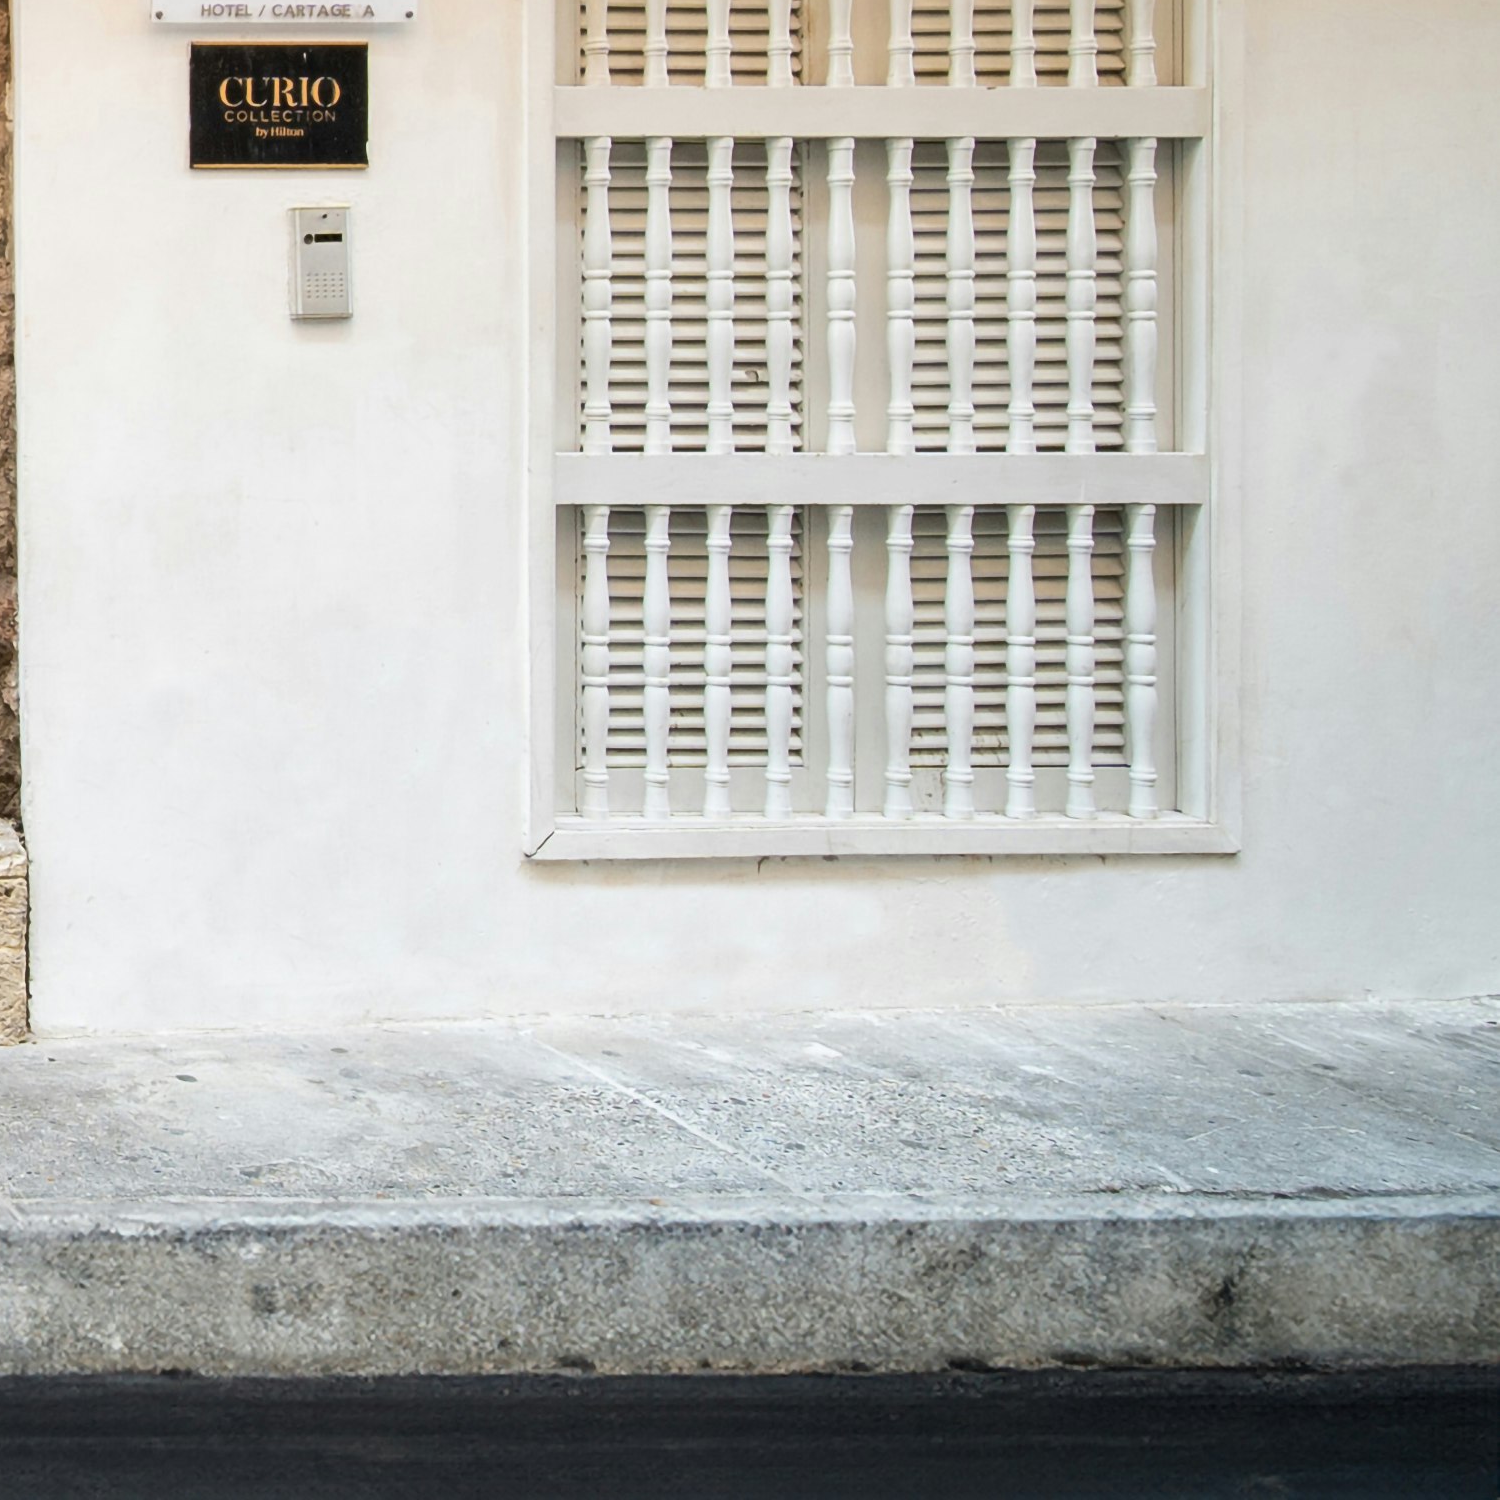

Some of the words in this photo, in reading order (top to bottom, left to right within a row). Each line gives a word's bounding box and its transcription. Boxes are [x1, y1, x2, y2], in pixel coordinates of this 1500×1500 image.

[200, 3, 252, 17] HOTEL
[271, 3, 376, 18] CARTAGEA
[218, 76, 341, 108] CURIO
[224, 110, 336, 123] COLLECTION
[255, 127, 268, 139] by
[270, 126, 305, 137] Hilton
